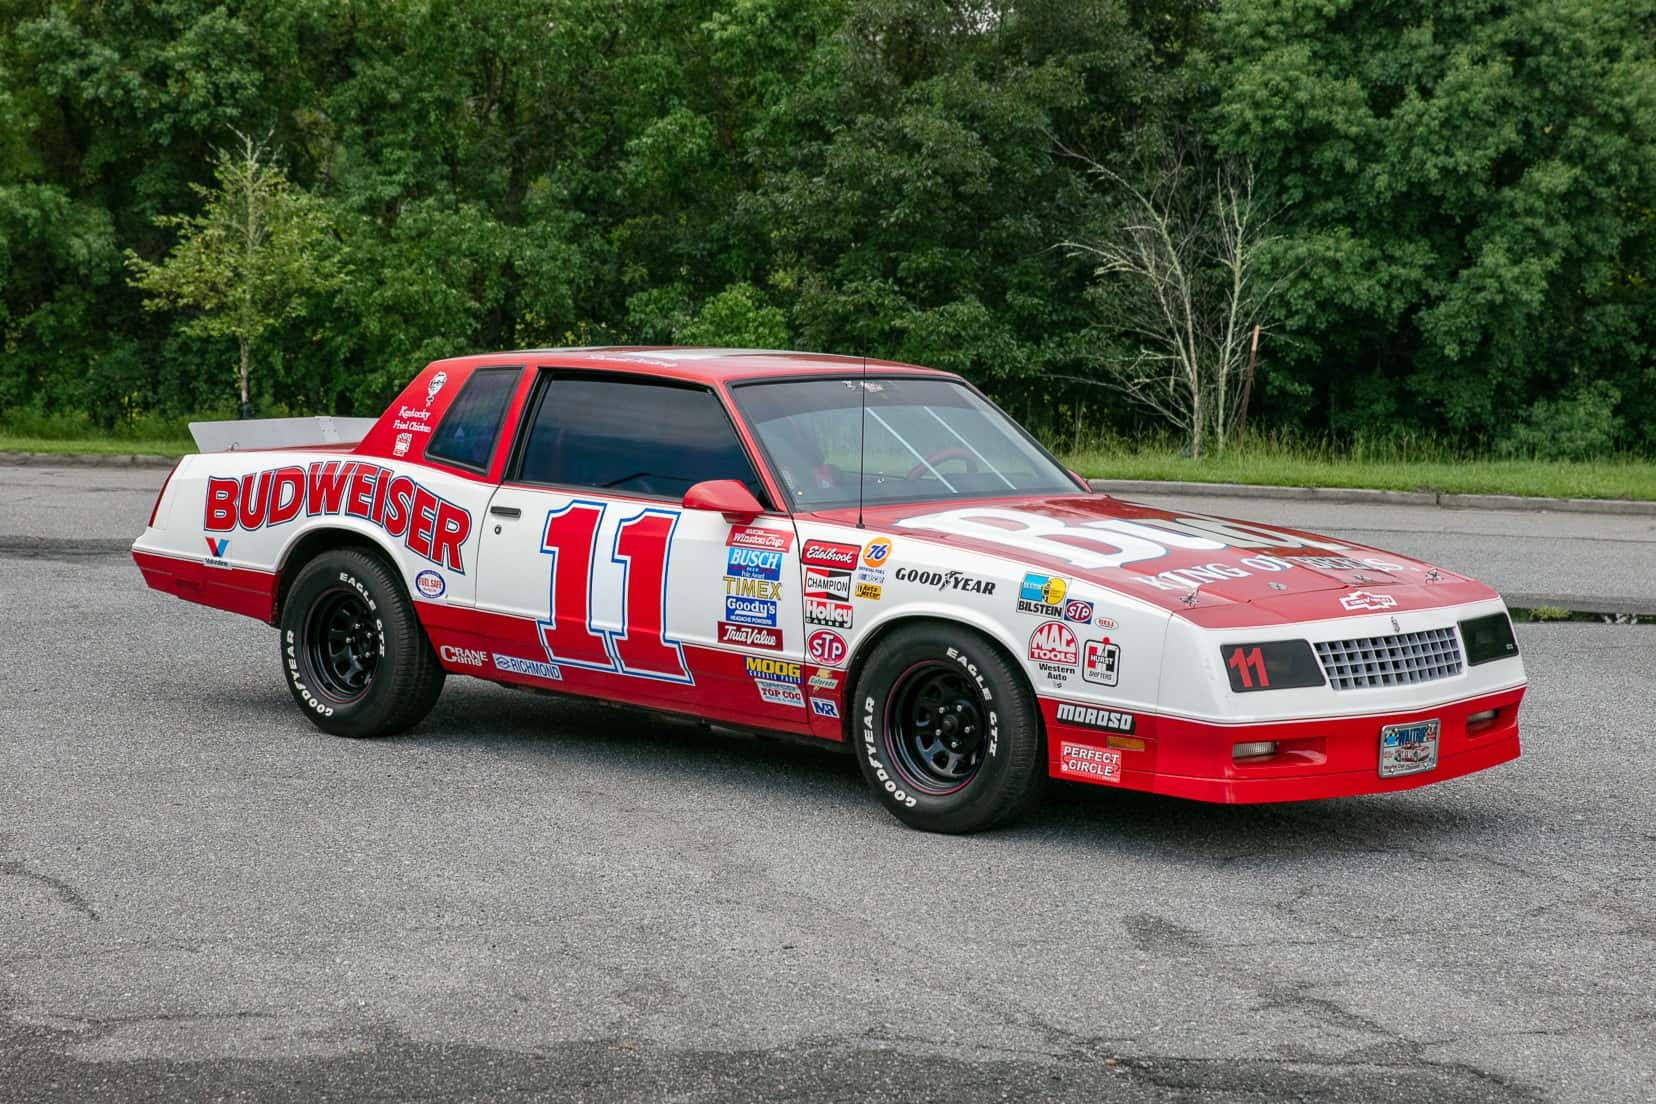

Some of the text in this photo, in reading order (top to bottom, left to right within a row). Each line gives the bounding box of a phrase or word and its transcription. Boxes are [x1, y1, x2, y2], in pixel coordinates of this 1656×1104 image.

[204, 461, 472, 576] BUDWEISER
[730, 548, 780, 569] BUSCH
[806, 545, 854, 564] Edelbrock
[866, 544, 888, 560] 76
[807, 577, 849, 593] CHAMPION
[1135, 563, 1253, 591] KING
[339, 572, 377, 611] EAGLE
[536, 499, 696, 686] 11
[723, 576, 782, 601] TIMEX
[727, 598, 776, 617] Goody's
[806, 600, 852, 628] Holley
[1018, 601, 1063, 617] BILSTEIN
[1069, 603, 1090, 618] STP
[812, 634, 842, 659] STP
[1032, 624, 1077, 653] MAC
[440, 645, 489, 663] CRANE
[1031, 649, 1075, 663] TOOLS
[286, 630, 334, 718] GOODYEAR
[511, 658, 560, 679] RICHMOND
[746, 657, 801, 678] MOOG
[945, 647, 993, 702] EAGLE
[1039, 663, 1076, 675] Western
[1047, 672, 1067, 682] Auto
[1229, 647, 1270, 689] 11
[760, 687, 781, 698] TOP
[1056, 703, 1133, 731] MOROSO
[863, 697, 918, 809] GOODYEAR
[1063, 746, 1120, 764] PERFECT
[1068, 760, 1113, 776] CIRCLE
